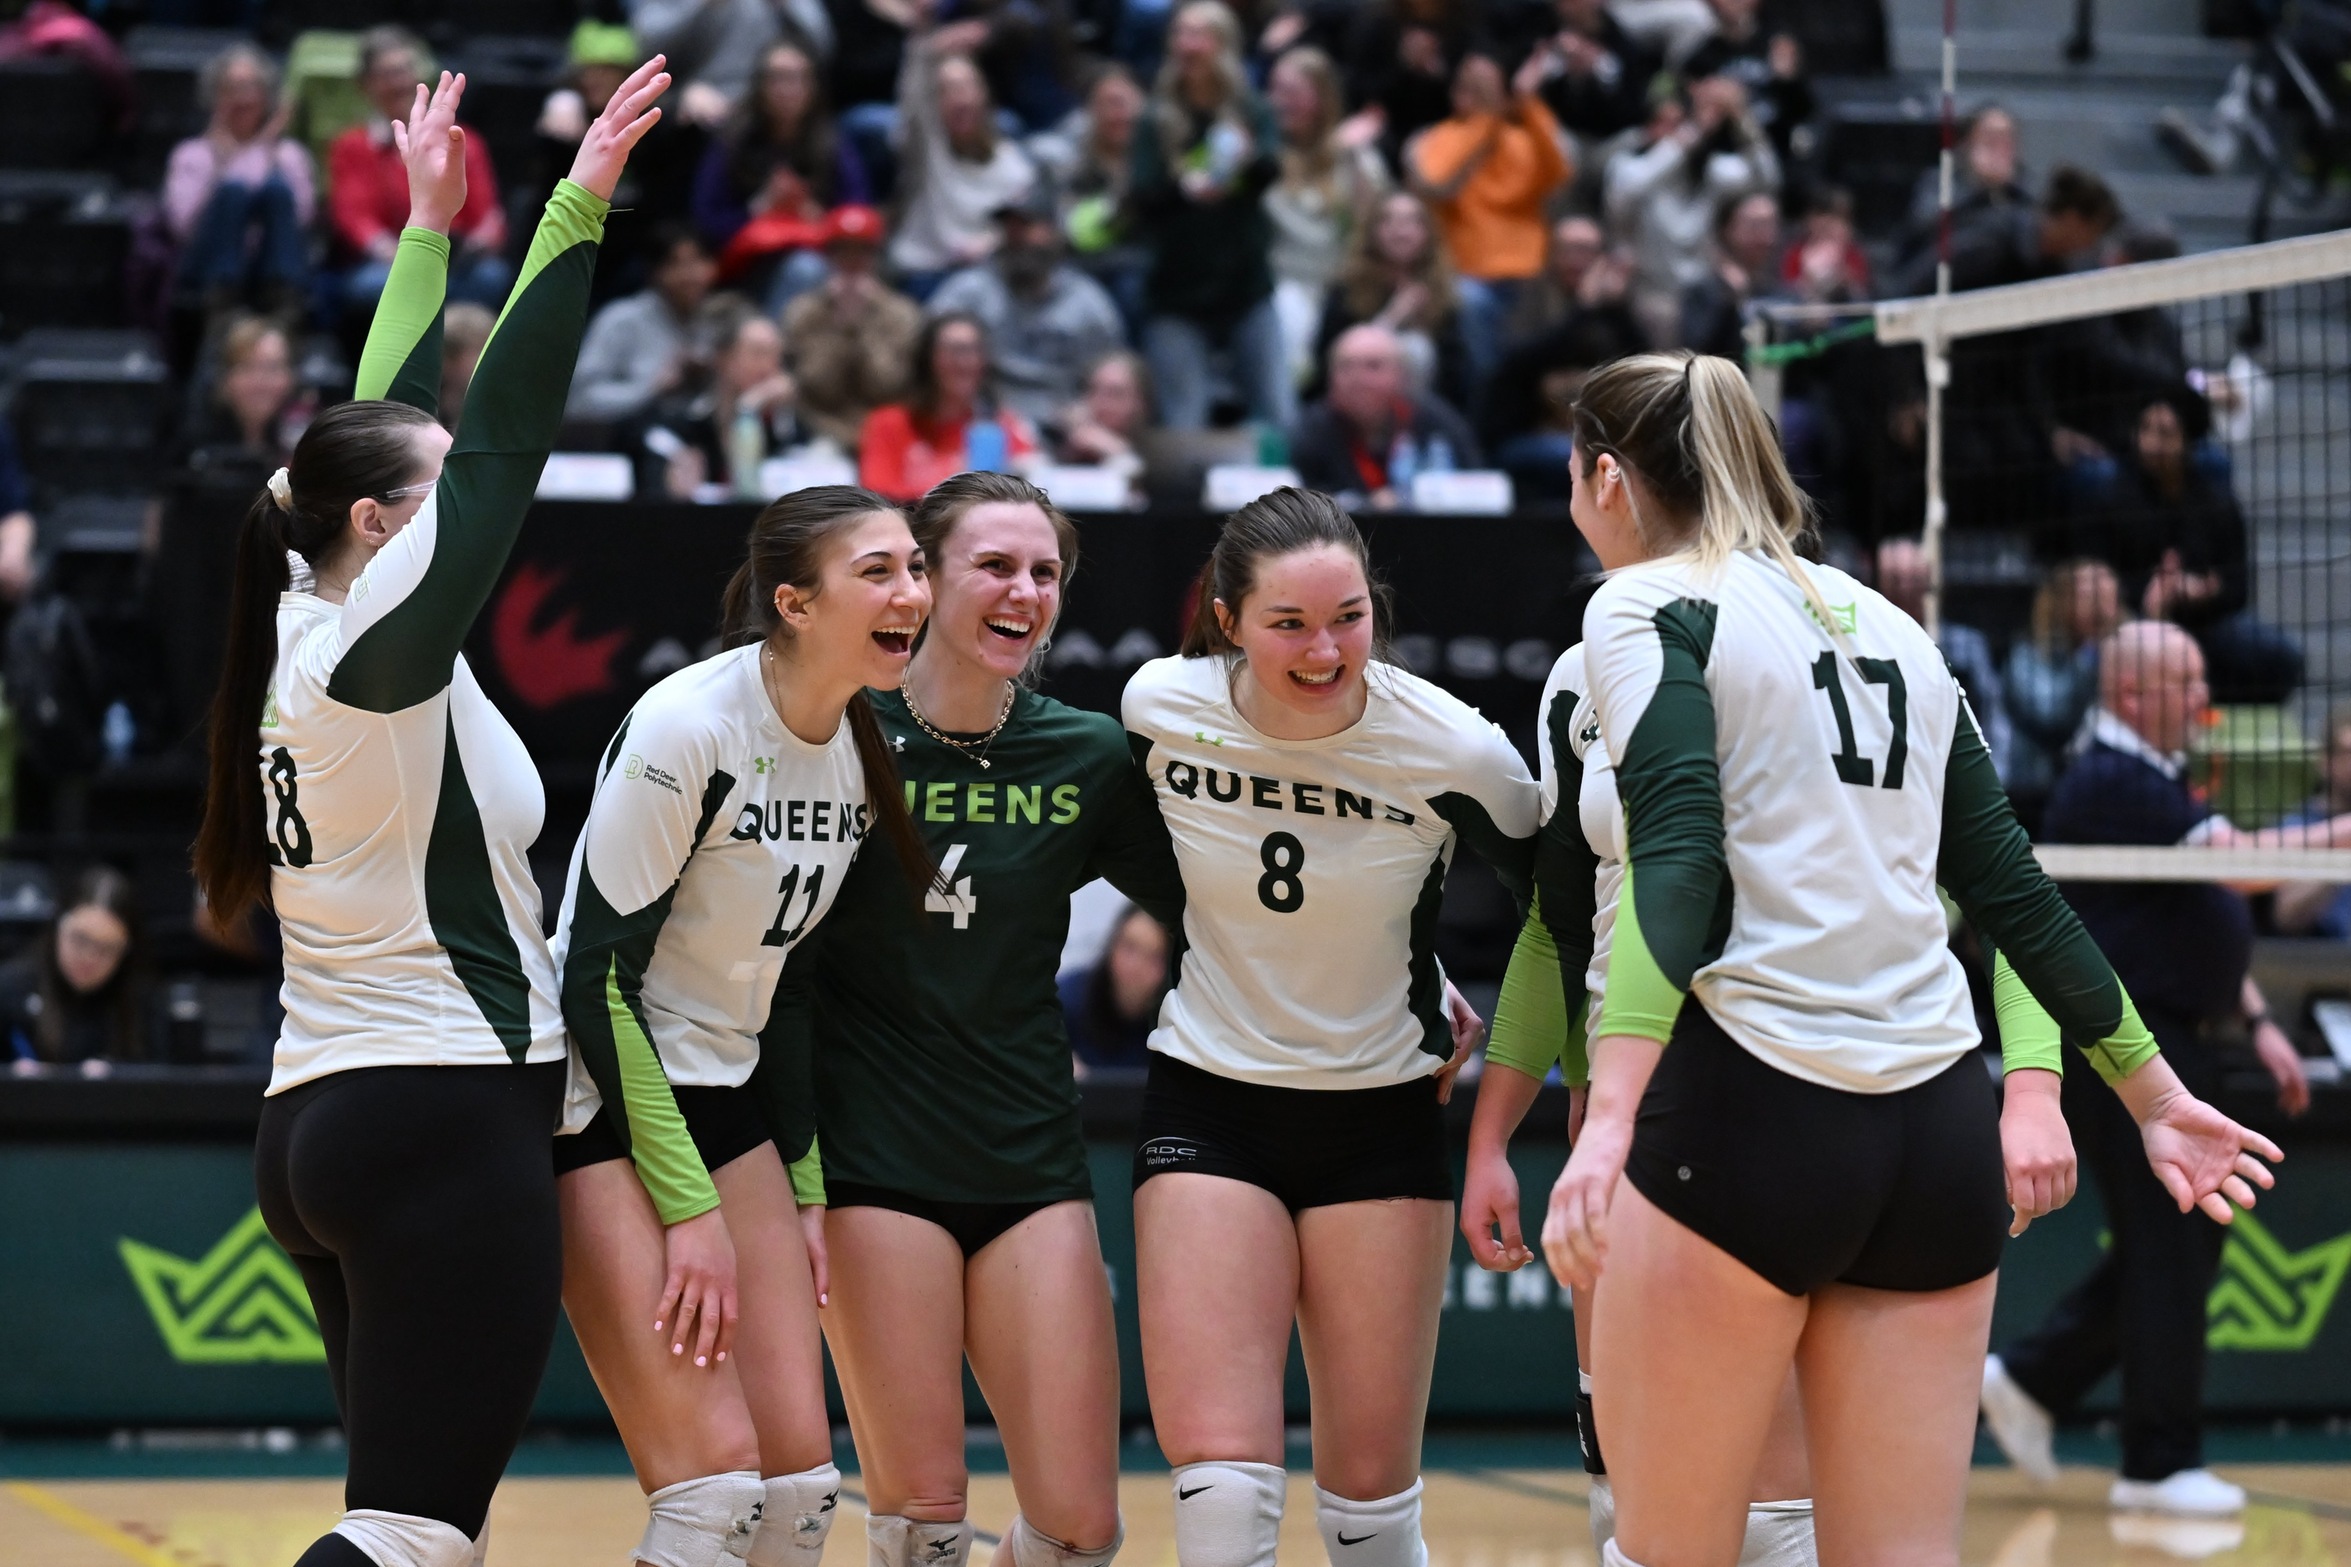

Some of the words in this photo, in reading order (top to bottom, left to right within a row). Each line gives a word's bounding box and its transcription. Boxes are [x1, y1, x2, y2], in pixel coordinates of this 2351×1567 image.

[1811, 650, 1908, 790] 17
[266, 746, 313, 868] 8
[643, 772, 683, 795] Polytechnic
[646, 764, 661, 775] Red
[660, 770, 677, 783] Deer
[1165, 760, 1415, 825] QUEENS
[729, 800, 868, 844] QUEENS
[760, 863, 825, 947] 11
[924, 843, 977, 930] 4
[1257, 831, 1305, 913] 8
[1146, 1146, 1197, 1156] RDC
